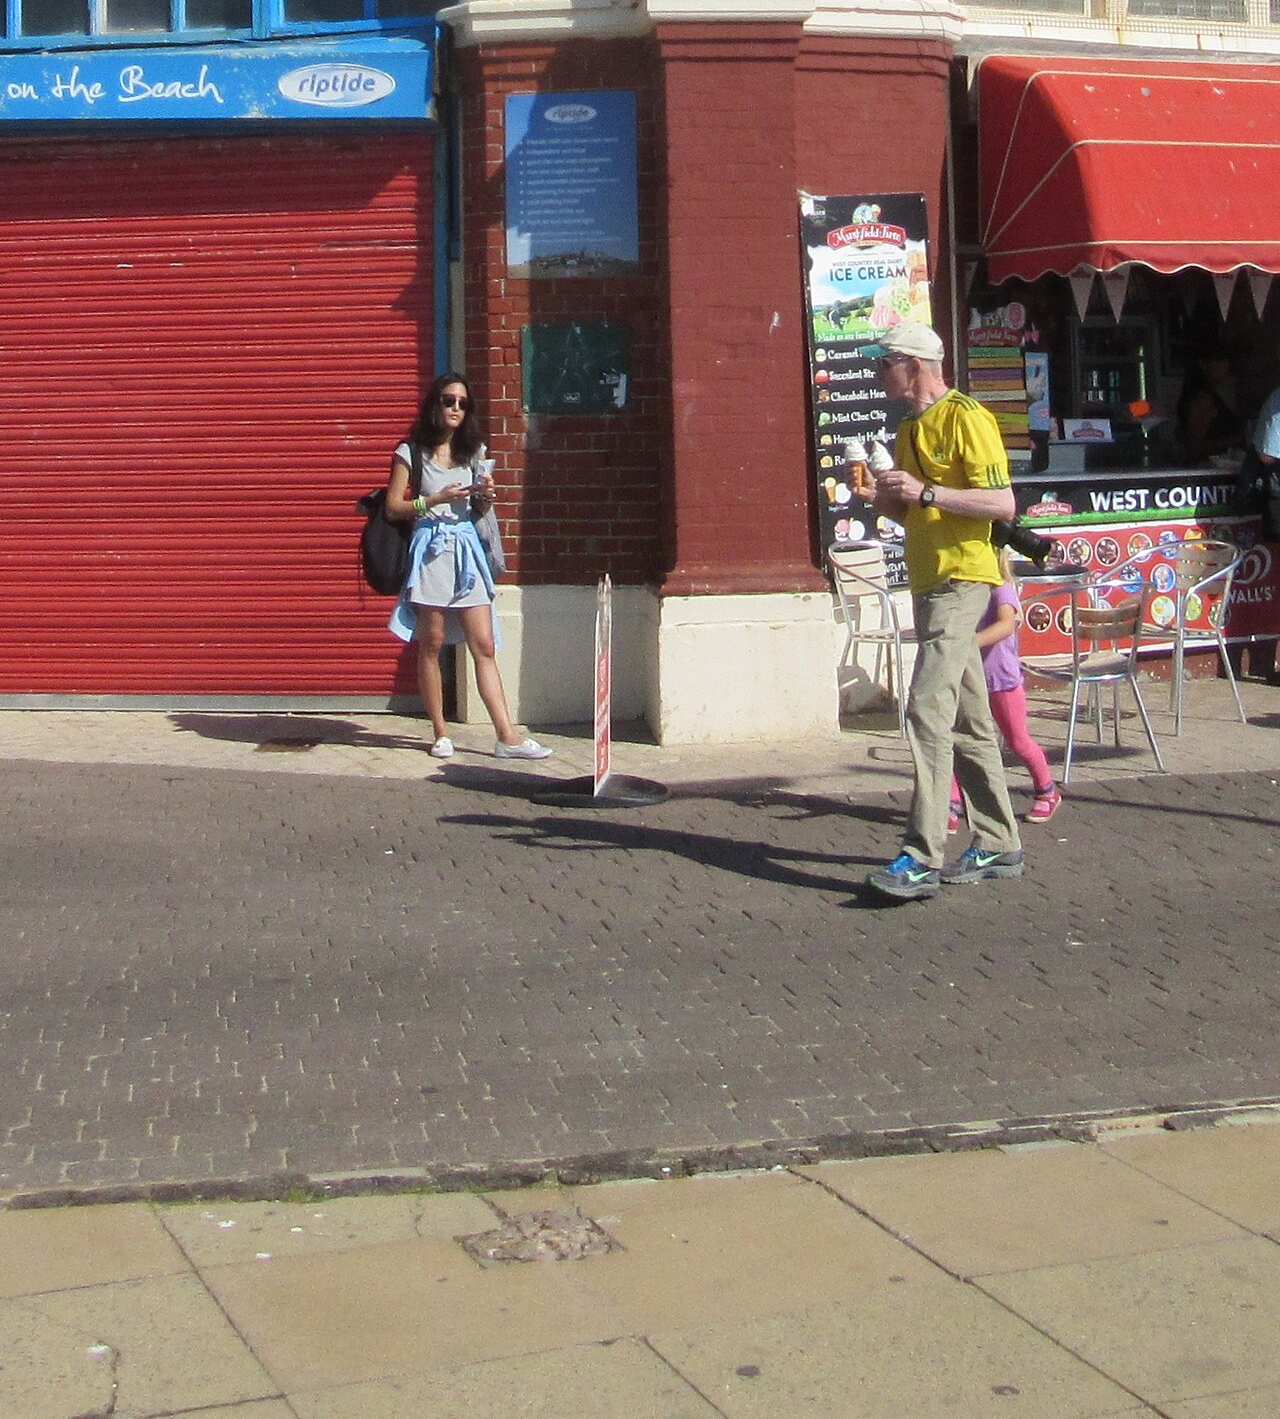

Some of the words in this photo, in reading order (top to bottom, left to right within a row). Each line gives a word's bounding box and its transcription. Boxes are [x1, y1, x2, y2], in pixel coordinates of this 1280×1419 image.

[6, 82, 40, 101] on
[50, 67, 107, 102] the
[117, 65, 224, 105] Beach
[297, 74, 376, 100] riptide
[829, 268, 853, 282] ICE
[857, 266, 908, 280] CREAM
[1090, 489, 1150, 511] WEST
[1154, 486, 1235, 508] COUNT
